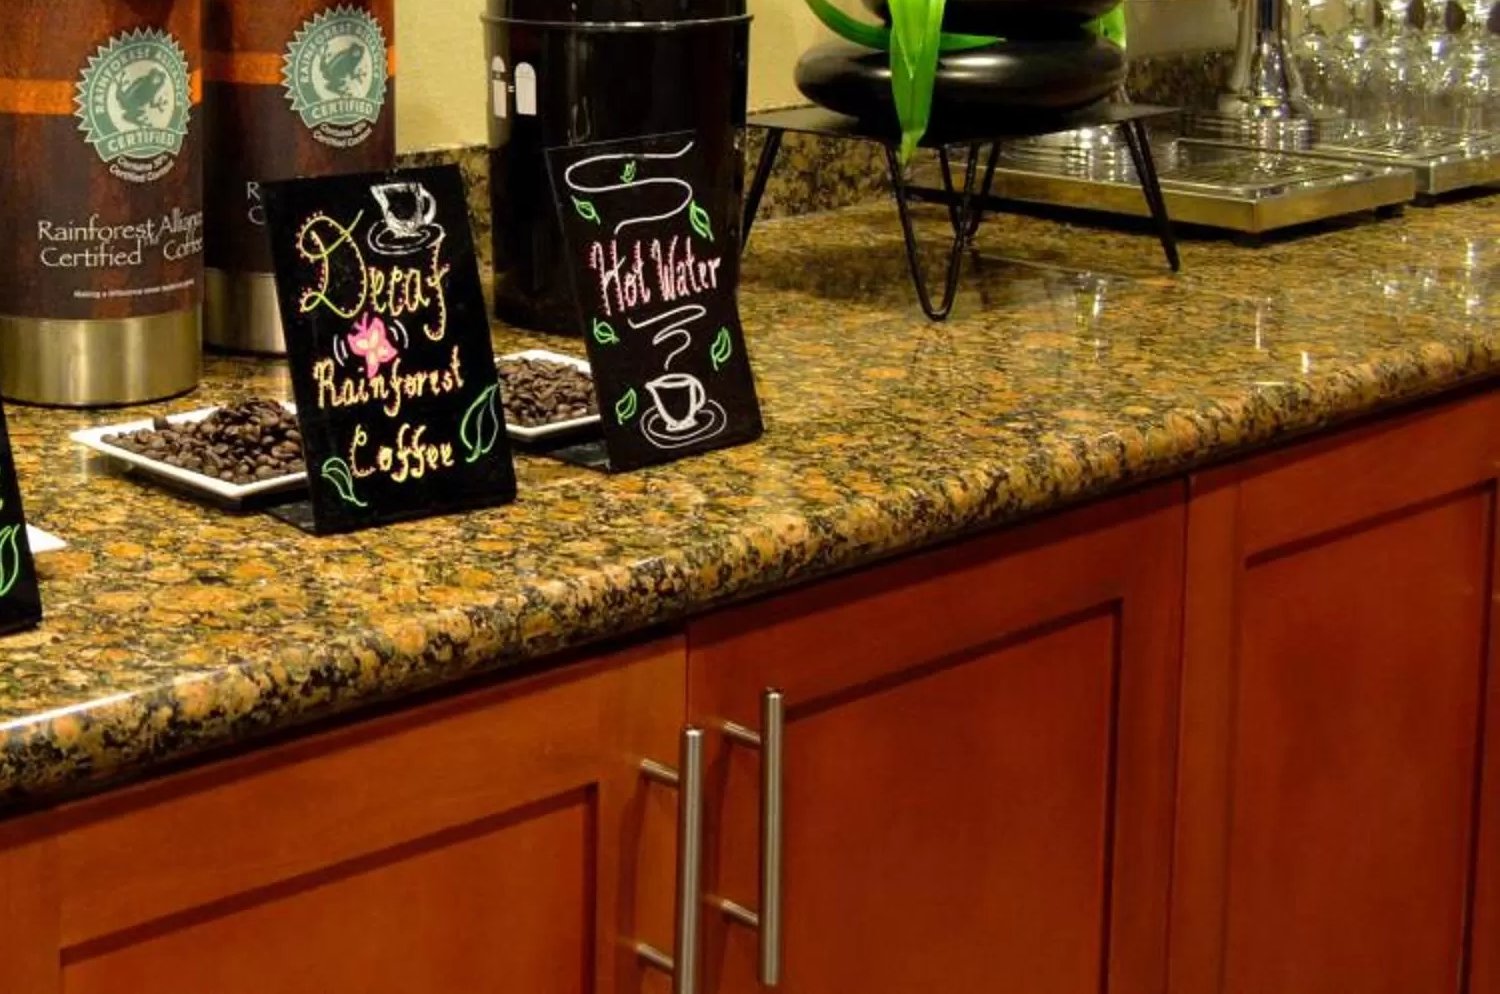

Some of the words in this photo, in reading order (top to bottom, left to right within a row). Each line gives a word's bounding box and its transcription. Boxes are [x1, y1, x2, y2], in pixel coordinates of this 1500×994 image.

[311, 101, 373, 119] CERTIFIED
[107, 133, 176, 152] CERTIFIED
[37, 213, 156, 244] Rainforest
[40, 237, 143, 268] Certified
[296, 209, 450, 341] Decaf
[589, 239, 651, 316] Hot
[651, 235, 722, 301] Water
[311, 345, 465, 418] Rainforest
[350, 423, 455, 483] Coffee
